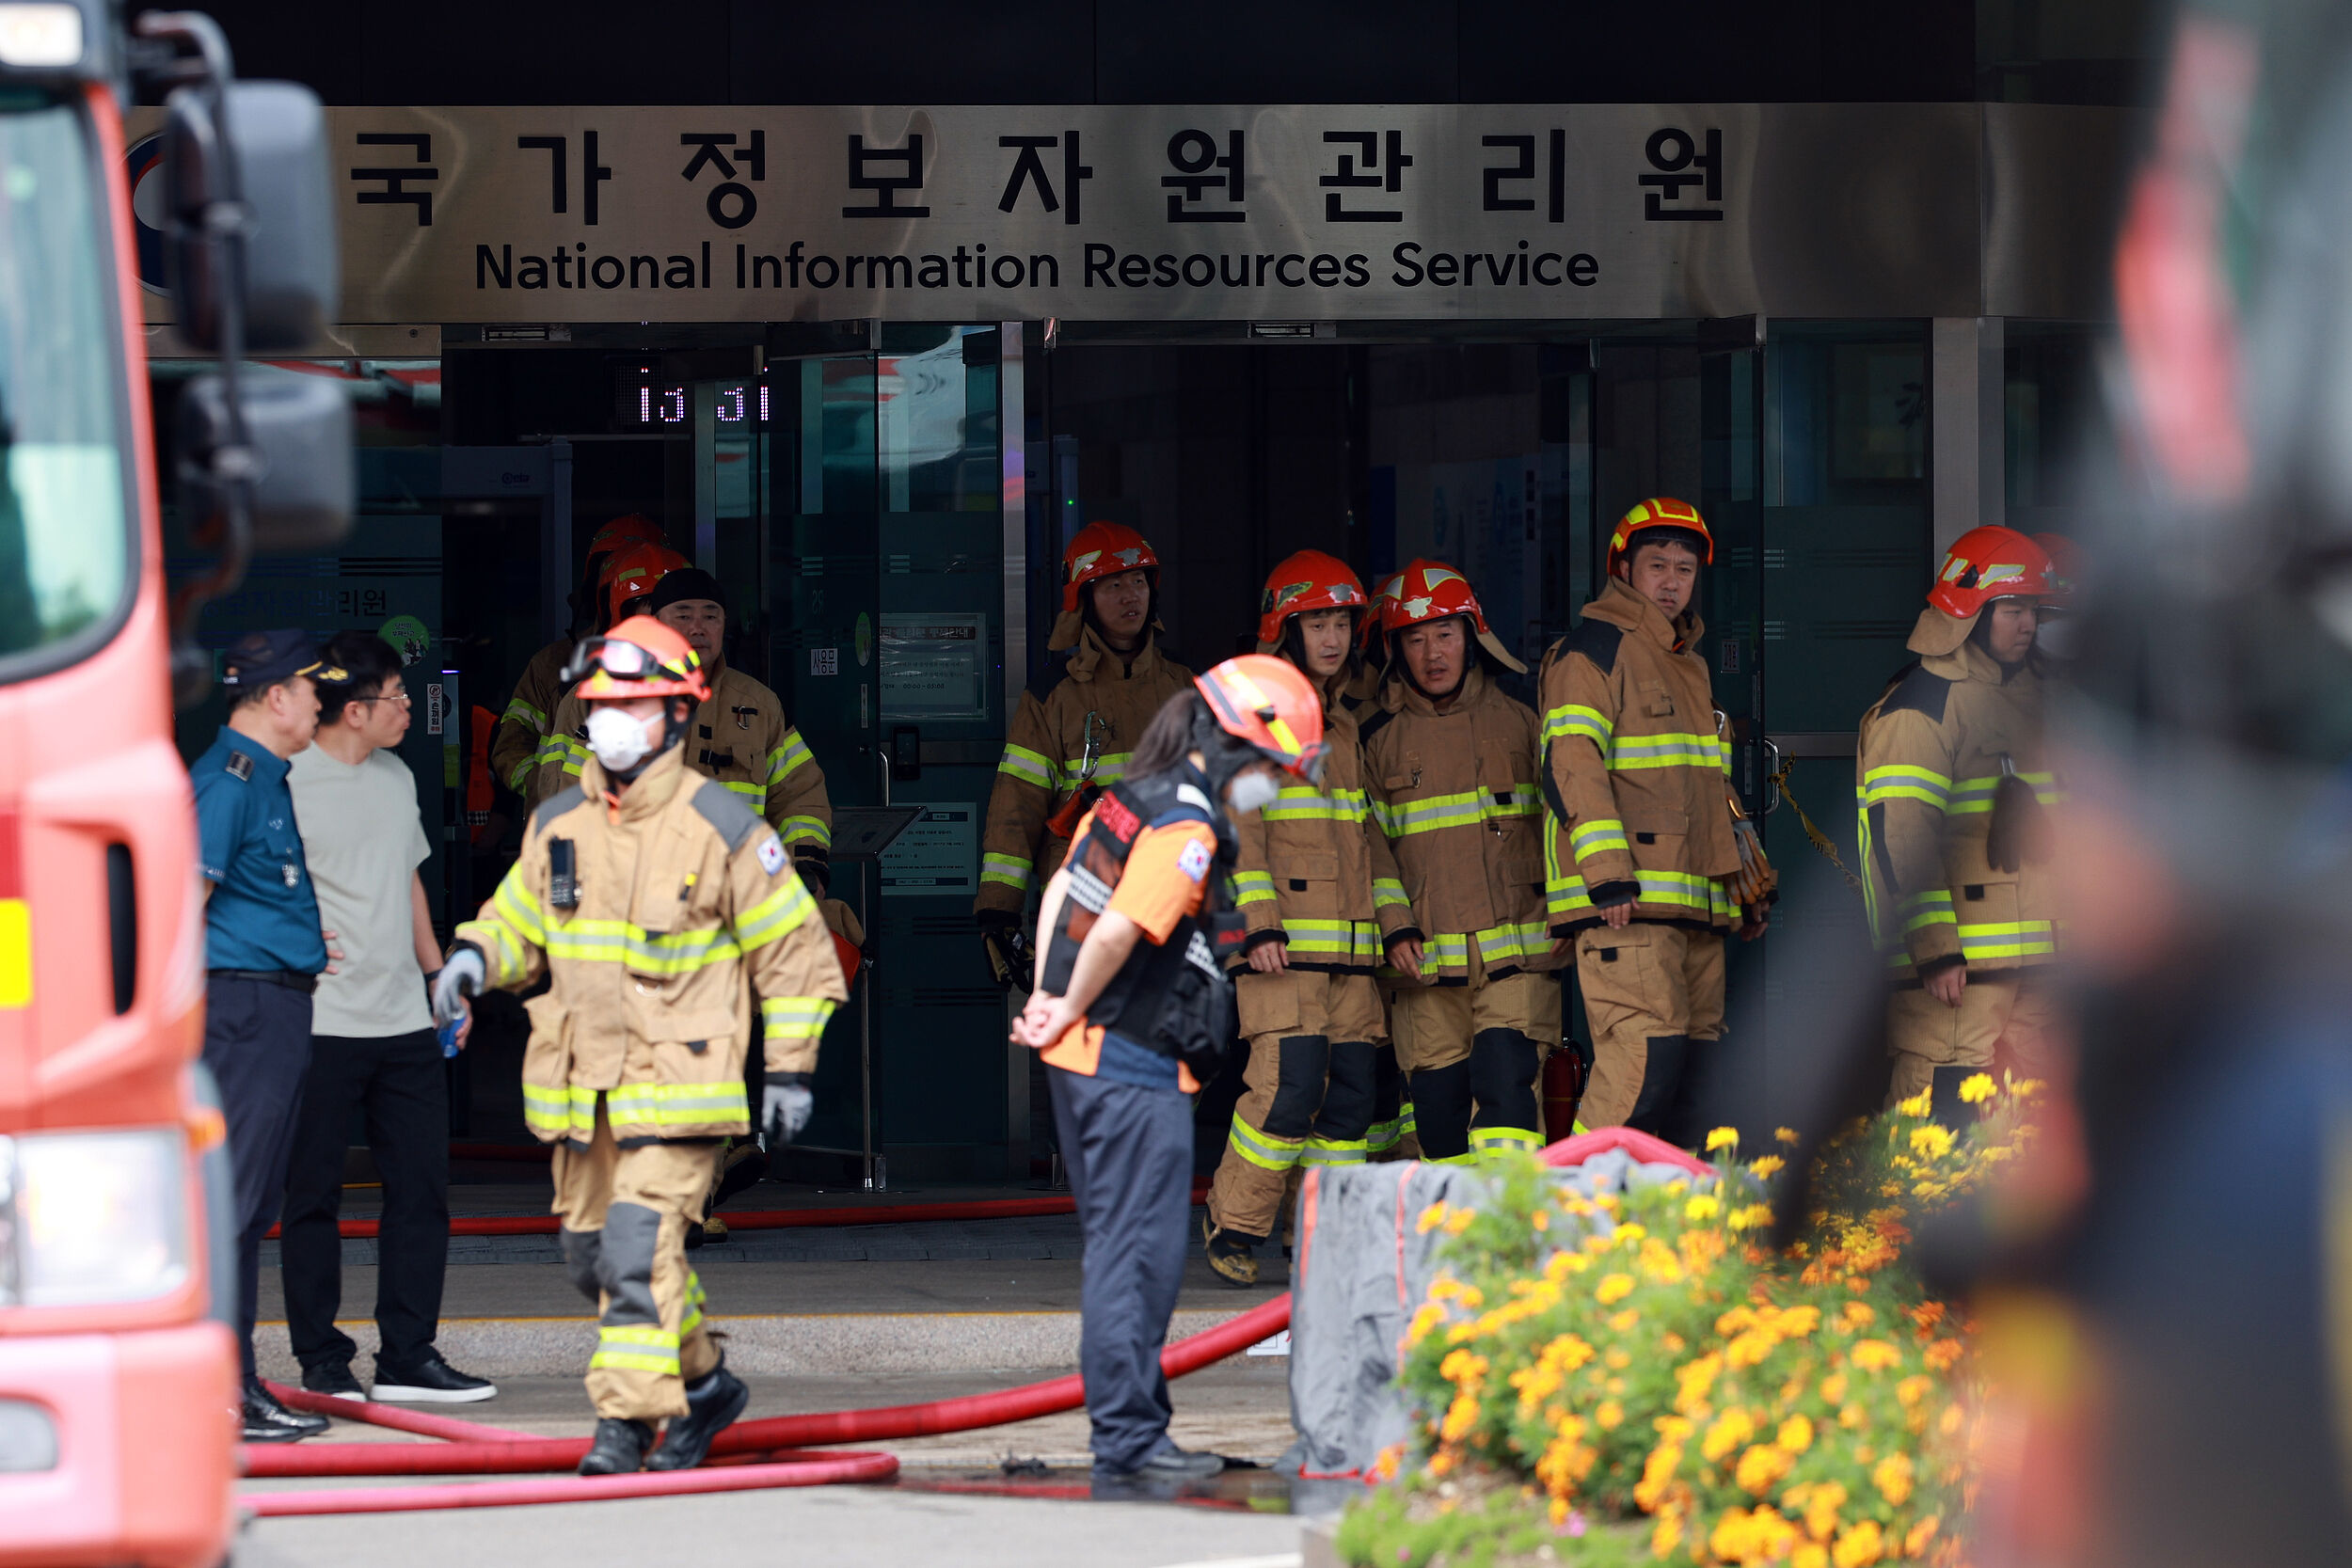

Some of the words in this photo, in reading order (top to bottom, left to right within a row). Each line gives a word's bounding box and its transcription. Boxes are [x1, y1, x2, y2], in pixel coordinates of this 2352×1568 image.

[350, 128, 1724, 230] 국가정보자원관리원
[476, 241, 711, 290] National
[736, 240, 1059, 289] Information
[1084, 243, 1371, 288] Resources
[1391, 239, 1599, 288] Service
[812, 649, 835, 674] 사용문
